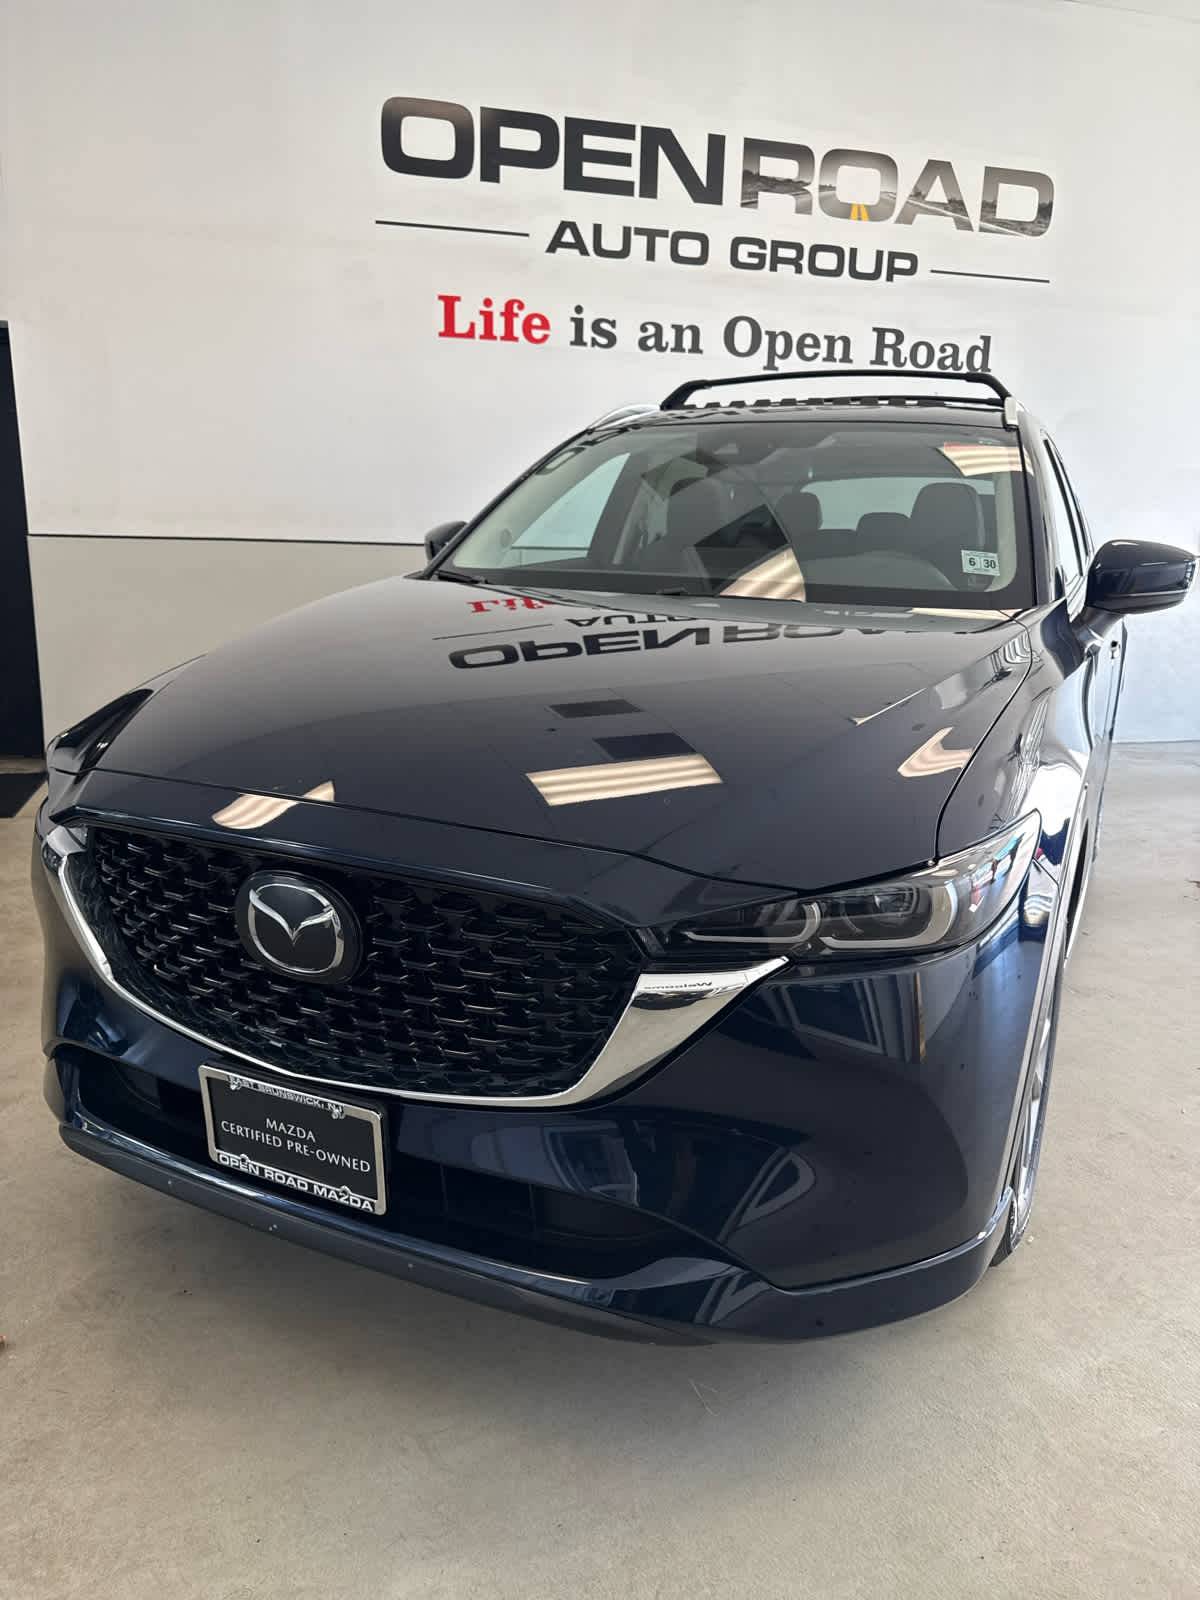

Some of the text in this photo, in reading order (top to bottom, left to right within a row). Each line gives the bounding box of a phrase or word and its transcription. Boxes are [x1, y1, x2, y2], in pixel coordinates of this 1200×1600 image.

[380, 96, 1055, 237] OPEN ROAD
[545, 220, 919, 283] AUTO GROUP
[437, 294, 993, 373] Life is an Open Road
[968, 557, 996, 570] 6 30
[221, 1120, 371, 1173] CERTIFIED PRE-OWNED
[266, 1117, 316, 1143] MAZDA
[219, 1154, 374, 1213] OPEN ROAD MAZDA
